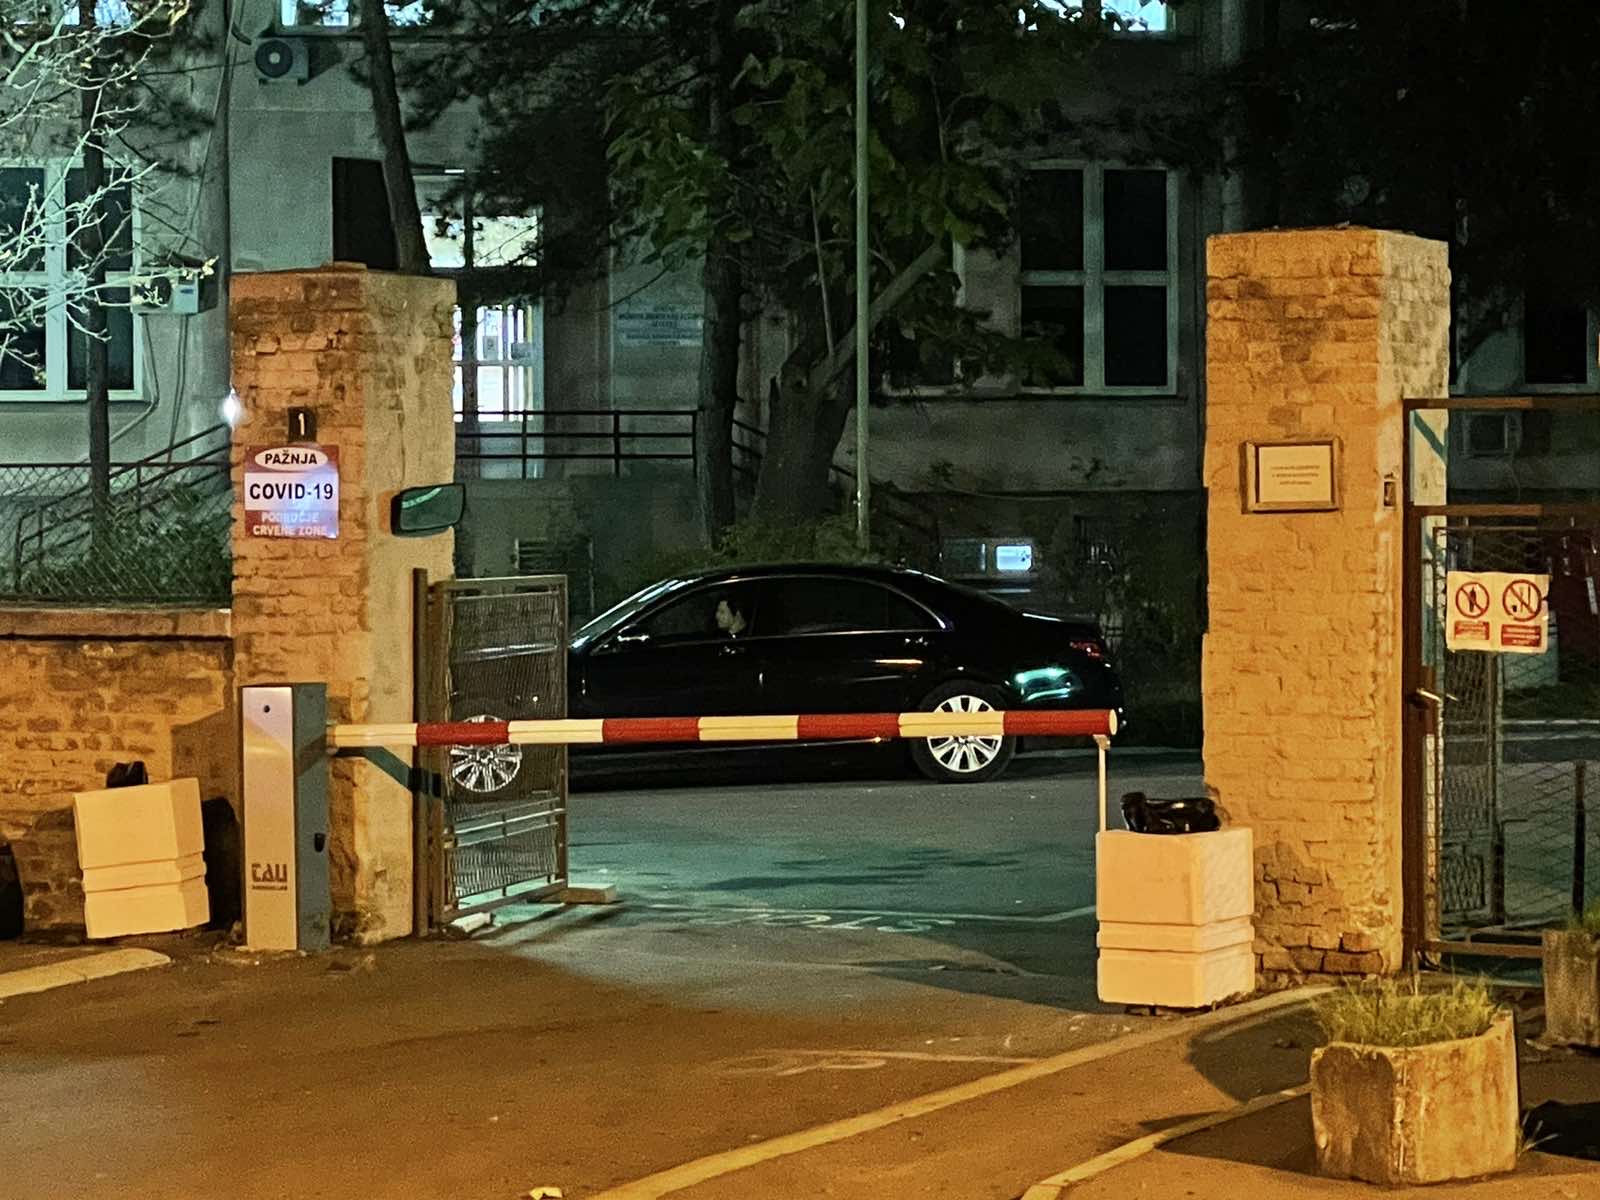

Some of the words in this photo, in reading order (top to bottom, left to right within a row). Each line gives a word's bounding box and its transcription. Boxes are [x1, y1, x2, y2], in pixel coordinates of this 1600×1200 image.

[298, 412, 305, 435] 1
[264, 449, 317, 465] PAŽNJA
[249, 483, 333, 500] COVID-19
